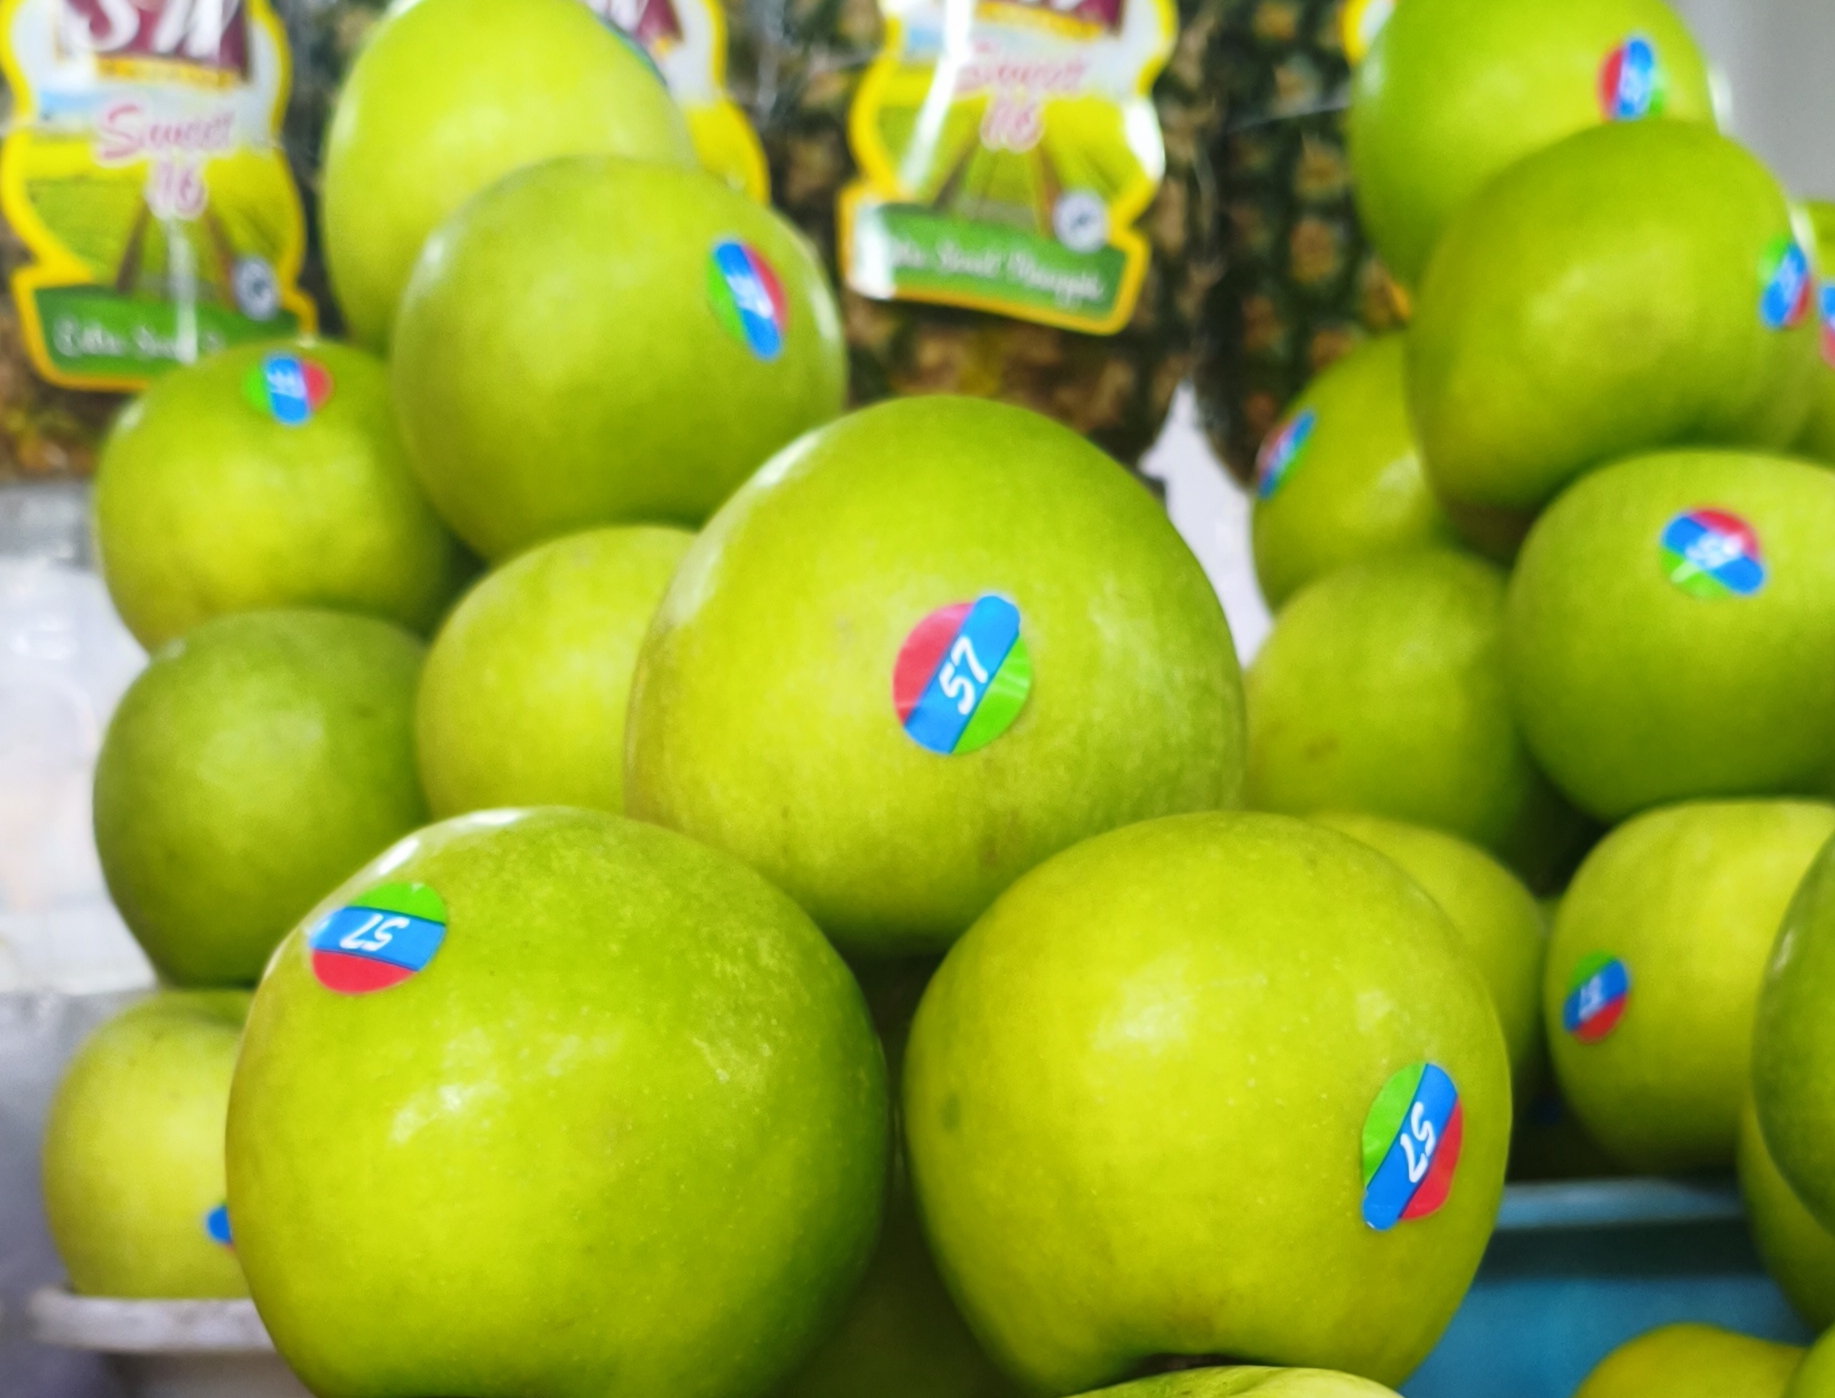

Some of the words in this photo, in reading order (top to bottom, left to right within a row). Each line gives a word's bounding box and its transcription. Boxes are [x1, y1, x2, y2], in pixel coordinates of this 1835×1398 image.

[101, 102, 236, 160] Sweet
[938, 635, 989, 715] 57
[339, 913, 410, 951] 57
[1400, 1101, 1436, 1183] 57
